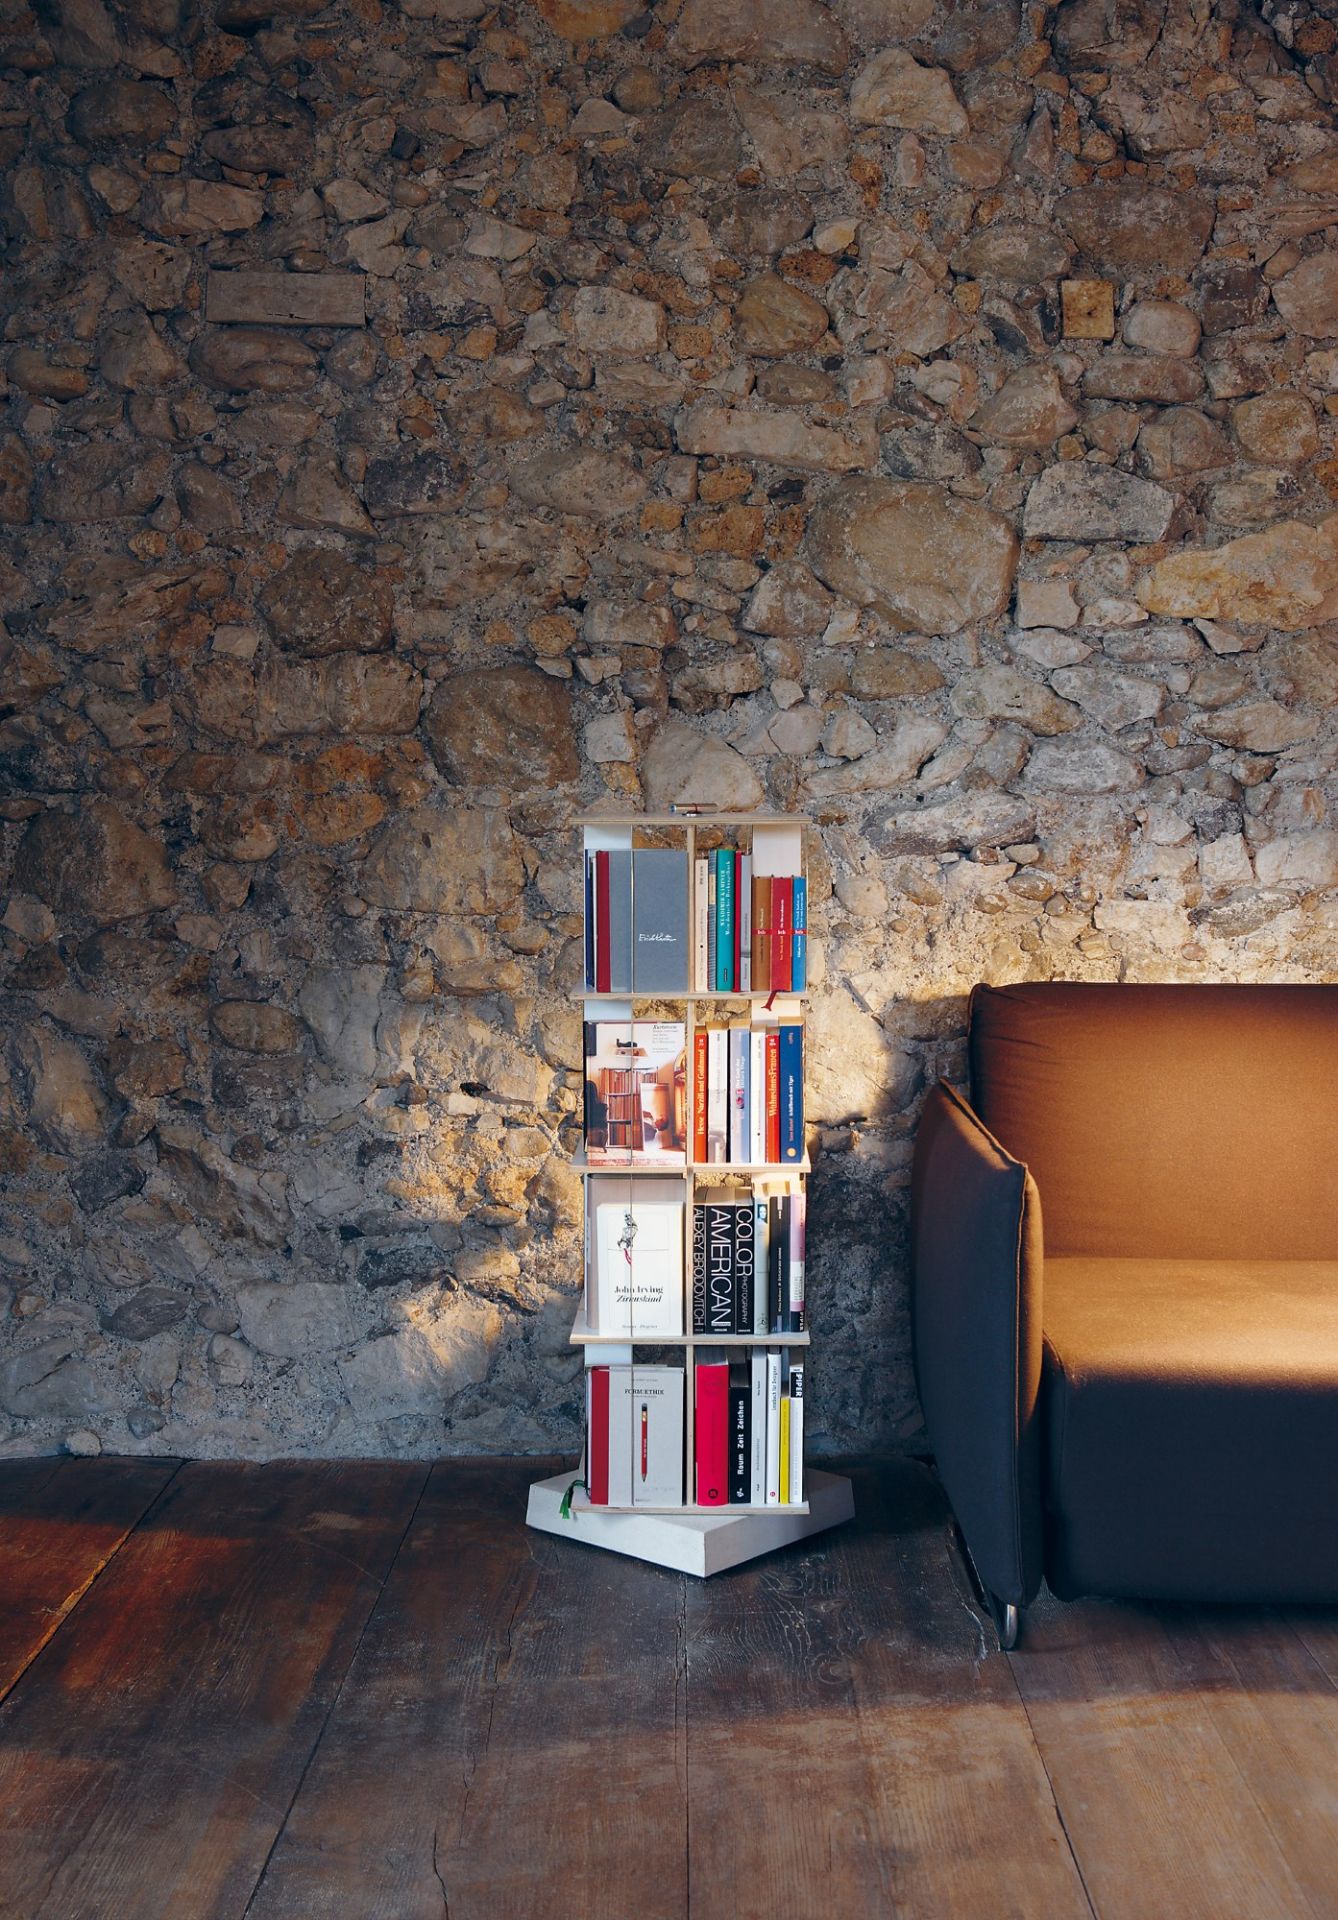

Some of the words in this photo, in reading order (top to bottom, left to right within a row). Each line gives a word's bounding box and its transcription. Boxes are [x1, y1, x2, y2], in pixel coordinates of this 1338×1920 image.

[768, 1048, 777, 1117] WahnsinnsFrauen
[697, 1116, 705, 1135] Hesse
[694, 1208, 704, 1250] ALEXEY
[736, 1208, 753, 1277] COLOR
[614, 1285, 635, 1294] John
[637, 1285, 664, 1294] Irving
[694, 1252, 704, 1326] BRODOVITCH
[711, 1208, 732, 1323] AMERICAN
[795, 1373, 803, 1397] PIPER
